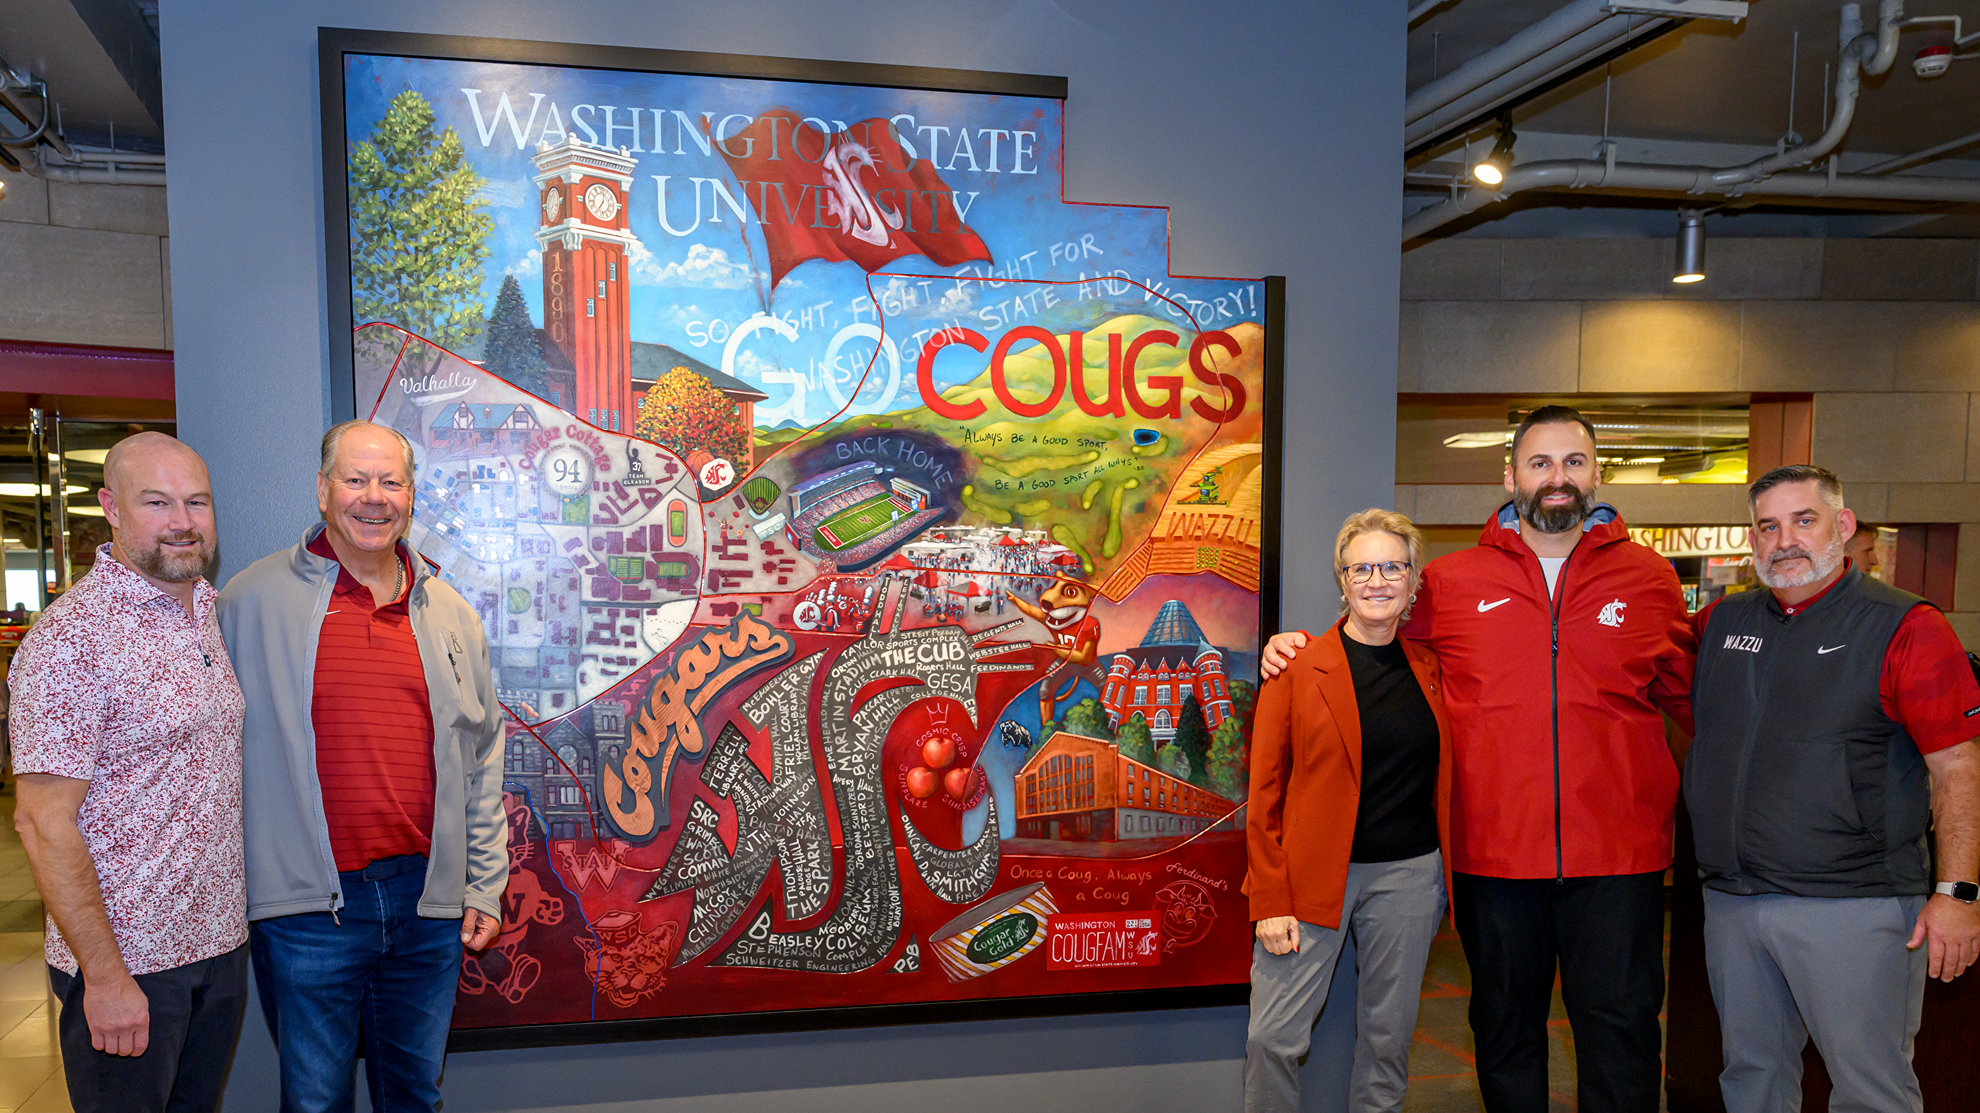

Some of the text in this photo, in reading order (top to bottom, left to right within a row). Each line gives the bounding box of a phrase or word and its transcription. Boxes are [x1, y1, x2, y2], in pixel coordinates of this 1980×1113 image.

[461, 88, 1038, 175] WASHINGTON STATE
[550, 251, 566, 343] 1890
[684, 319, 729, 348] SO
[1050, 233, 1103, 269] FOR
[789, 269, 1258, 393] WASHINGTON STATE AND VICTORY!
[400, 372, 477, 394] Valhalla
[721, 318, 1246, 426] GO COUGS
[519, 424, 611, 472] Cougar Cottage
[1011, 433, 1025, 443] BE
[1032, 436, 1038, 444] A
[1042, 436, 1068, 445] GOOD
[1077, 438, 1108, 451] SPORT,
[553, 458, 583, 483] 94
[836, 436, 955, 490] BACK HOME
[995, 479, 1009, 490] BE
[1018, 481, 1024, 491] A
[1032, 479, 1056, 489] GOOD
[1063, 471, 1089, 485] SPORT
[1094, 464, 1105, 475] ALL
[1165, 511, 1254, 545] WAZZU
[1630, 527, 1750, 552] ASHINGTO
[869, 577, 890, 643] TODD HALL
[886, 636, 959, 650] SPORTS COMPLEX
[901, 630, 930, 639] STREIT
[972, 620, 1023, 642] REGENTS HALL
[1724, 634, 1763, 653] WAZZU
[840, 640, 885, 659] TAYLOR
[881, 642, 965, 667] THE CUB
[968, 646, 1010, 660] WEBSTER
[831, 656, 858, 678] ORTON
[869, 667, 920, 679] CLARK HALL
[946, 661, 966, 671] HALL
[748, 652, 824, 725] BOHLER GYM
[848, 674, 869, 696] CUE
[910, 690, 949, 700] COLLEGE
[927, 673, 972, 695] GESA
[790, 686, 800, 728] LIBRARY
[820, 681, 834, 744] HEALD HALL
[831, 653, 882, 771] MARTIN STADIUM
[852, 694, 886, 727] PACCAR
[771, 714, 784, 786] OLYMPIA HALL
[778, 699, 796, 775] FRIEL COURT
[852, 697, 900, 776] BRYAN HALL
[916, 727, 968, 758] COSMIC CRISP
[709, 735, 742, 789] TERRELL
[736, 754, 755, 776] THE
[824, 745, 837, 770] EME
[718, 760, 741, 797] LIBRARY
[743, 778, 761, 799] WHITE
[899, 764, 928, 809] SUNFLARE
[976, 764, 989, 796] MAGIC
[690, 800, 719, 828] SRC
[732, 791, 748, 835] STEVENS
[745, 786, 782, 816] STADIUM
[773, 775, 816, 826] JOHNSON HALL
[685, 821, 721, 851] GRIMES WAY
[749, 816, 794, 837] BUSTAD
[796, 829, 822, 840] HALL
[816, 812, 831, 873] CLEVELAND
[847, 786, 865, 870] JORDAN SCHNITZER
[901, 814, 924, 860] DUNCAN
[921, 828, 991, 859] CARPENTER HALL
[645, 830, 691, 900] WEGNER HALL
[677, 854, 730, 880] COMAN
[777, 838, 807, 902] THOMPSON HALL
[930, 857, 965, 869] GLOBAL
[931, 853, 992, 893] SMITH GYM
[1010, 864, 1043, 879] Once
[1107, 868, 1152, 886] Always
[1165, 862, 1229, 892] Ferdinand's
[662, 867, 731, 895] ELMINA WHITE
[695, 869, 747, 902] NORTHSIDE
[787, 840, 830, 919] THE SPARK
[693, 887, 731, 924] McCOY
[956, 890, 979, 905] FINE
[1076, 887, 1130, 906] a Coug
[688, 890, 742, 944] CHINOOK
[714, 900, 747, 935] CENTER
[748, 888, 872, 950] BEASLEY COLISEUM
[1055, 920, 1116, 931] WASHINGTON
[600, 924, 638, 944] WSC
[736, 937, 872, 961] STEPHENSON COMPLEX
[973, 928, 1011, 952] Cougar
[989, 937, 1015, 956] Gold
[1051, 931, 1126, 963] COUGFAM
[726, 953, 876, 972] SCHWEITZER ENGINEERING
[893, 943, 920, 974] PEB
